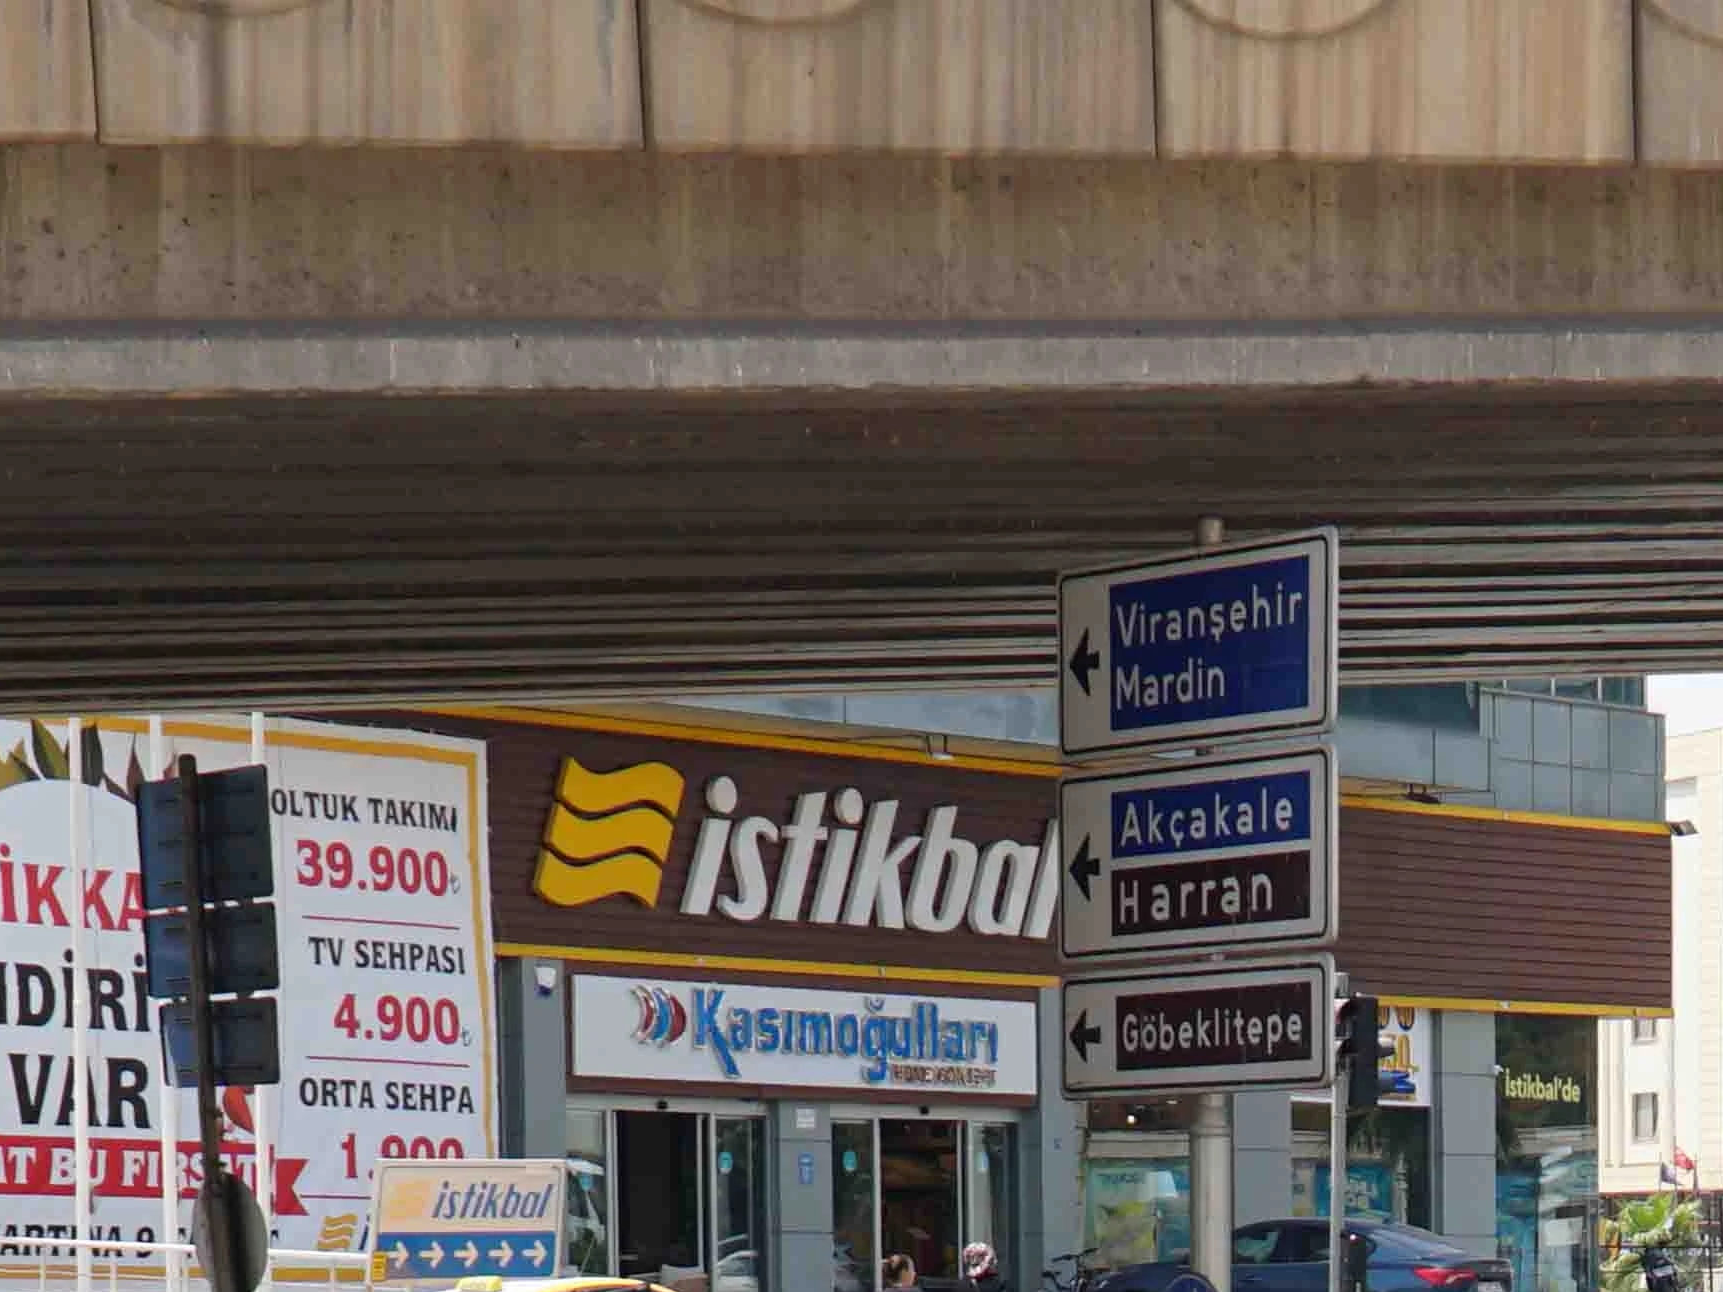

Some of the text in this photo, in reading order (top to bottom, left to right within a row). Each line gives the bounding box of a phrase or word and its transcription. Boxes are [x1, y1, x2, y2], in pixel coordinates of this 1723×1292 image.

[1115, 584, 1303, 647] Viranşehir
[1116, 657, 1226, 711] Mardin
[271, 788, 360, 823] OLTUK
[1119, 786, 1293, 848] Akçakale
[679, 775, 1060, 939] istikbal
[1118, 872, 1274, 924] Harran
[308, 935, 466, 975] TV SEHPASI
[692, 985, 999, 1082] Kasımoğulları
[1121, 1008, 1303, 1058] Göbeklitepe
[299, 1077, 476, 1115] ORTA SEHPA
[121, 1150, 259, 1191] FIRST
[431, 1180, 557, 1220] istikbal
